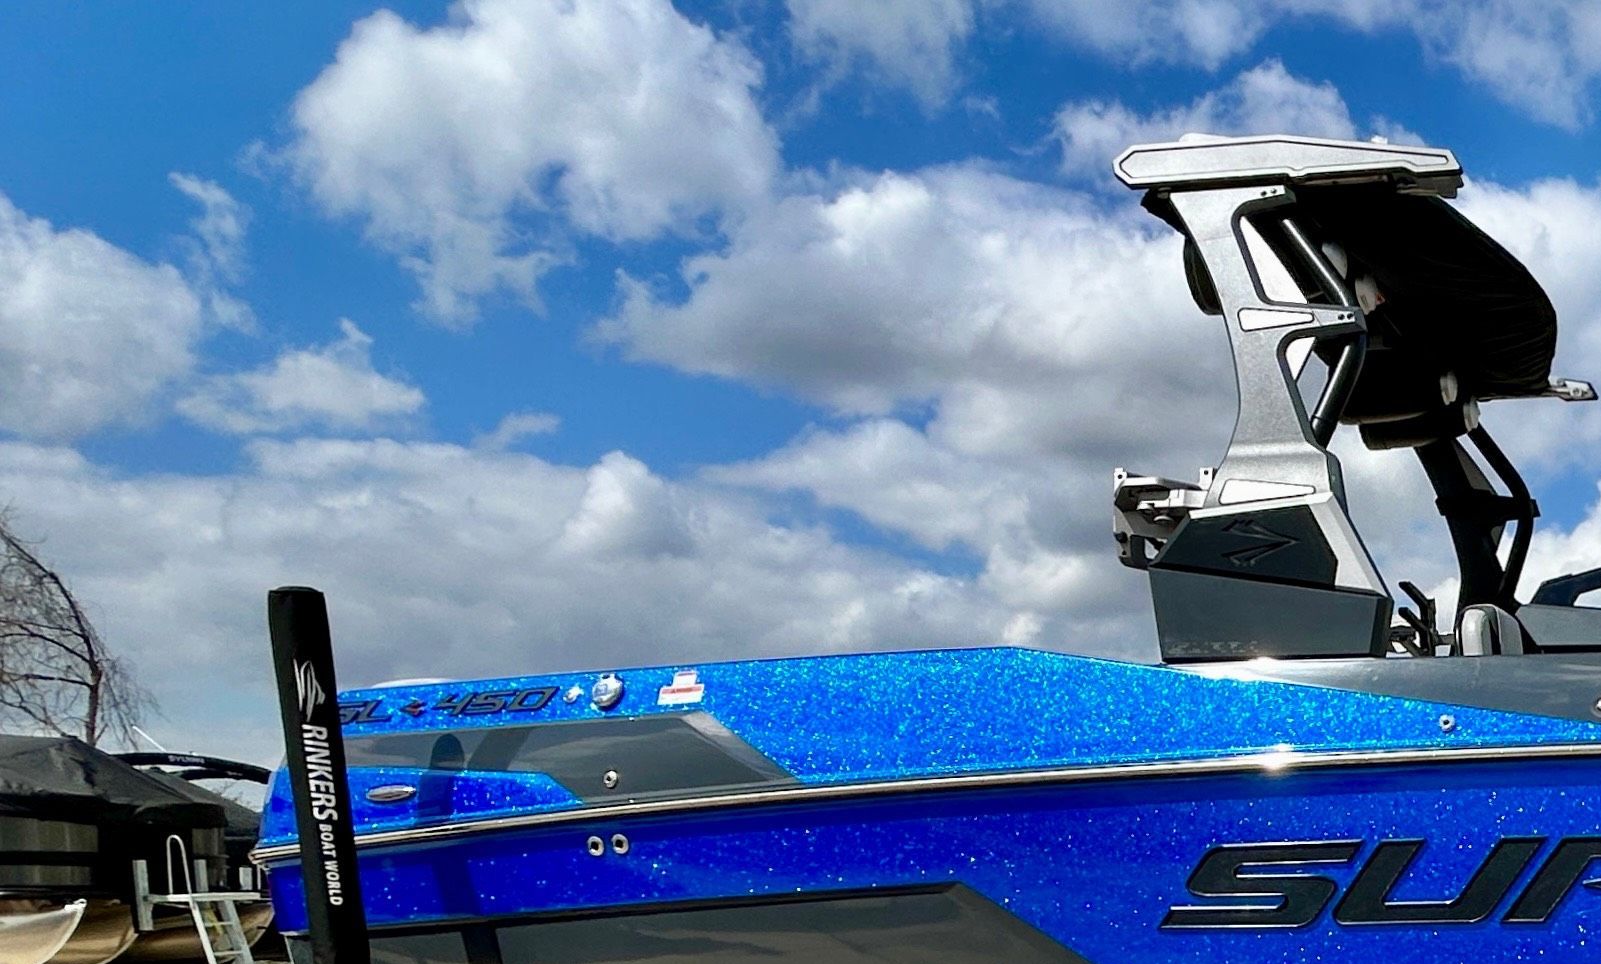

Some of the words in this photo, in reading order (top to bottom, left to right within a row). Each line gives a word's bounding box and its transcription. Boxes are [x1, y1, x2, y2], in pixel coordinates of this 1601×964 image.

[432, 686, 560, 717] 450
[301, 724, 339, 821] RINKERS
[319, 824, 337, 860] BOAT
[325, 860, 344, 906] WORLD
